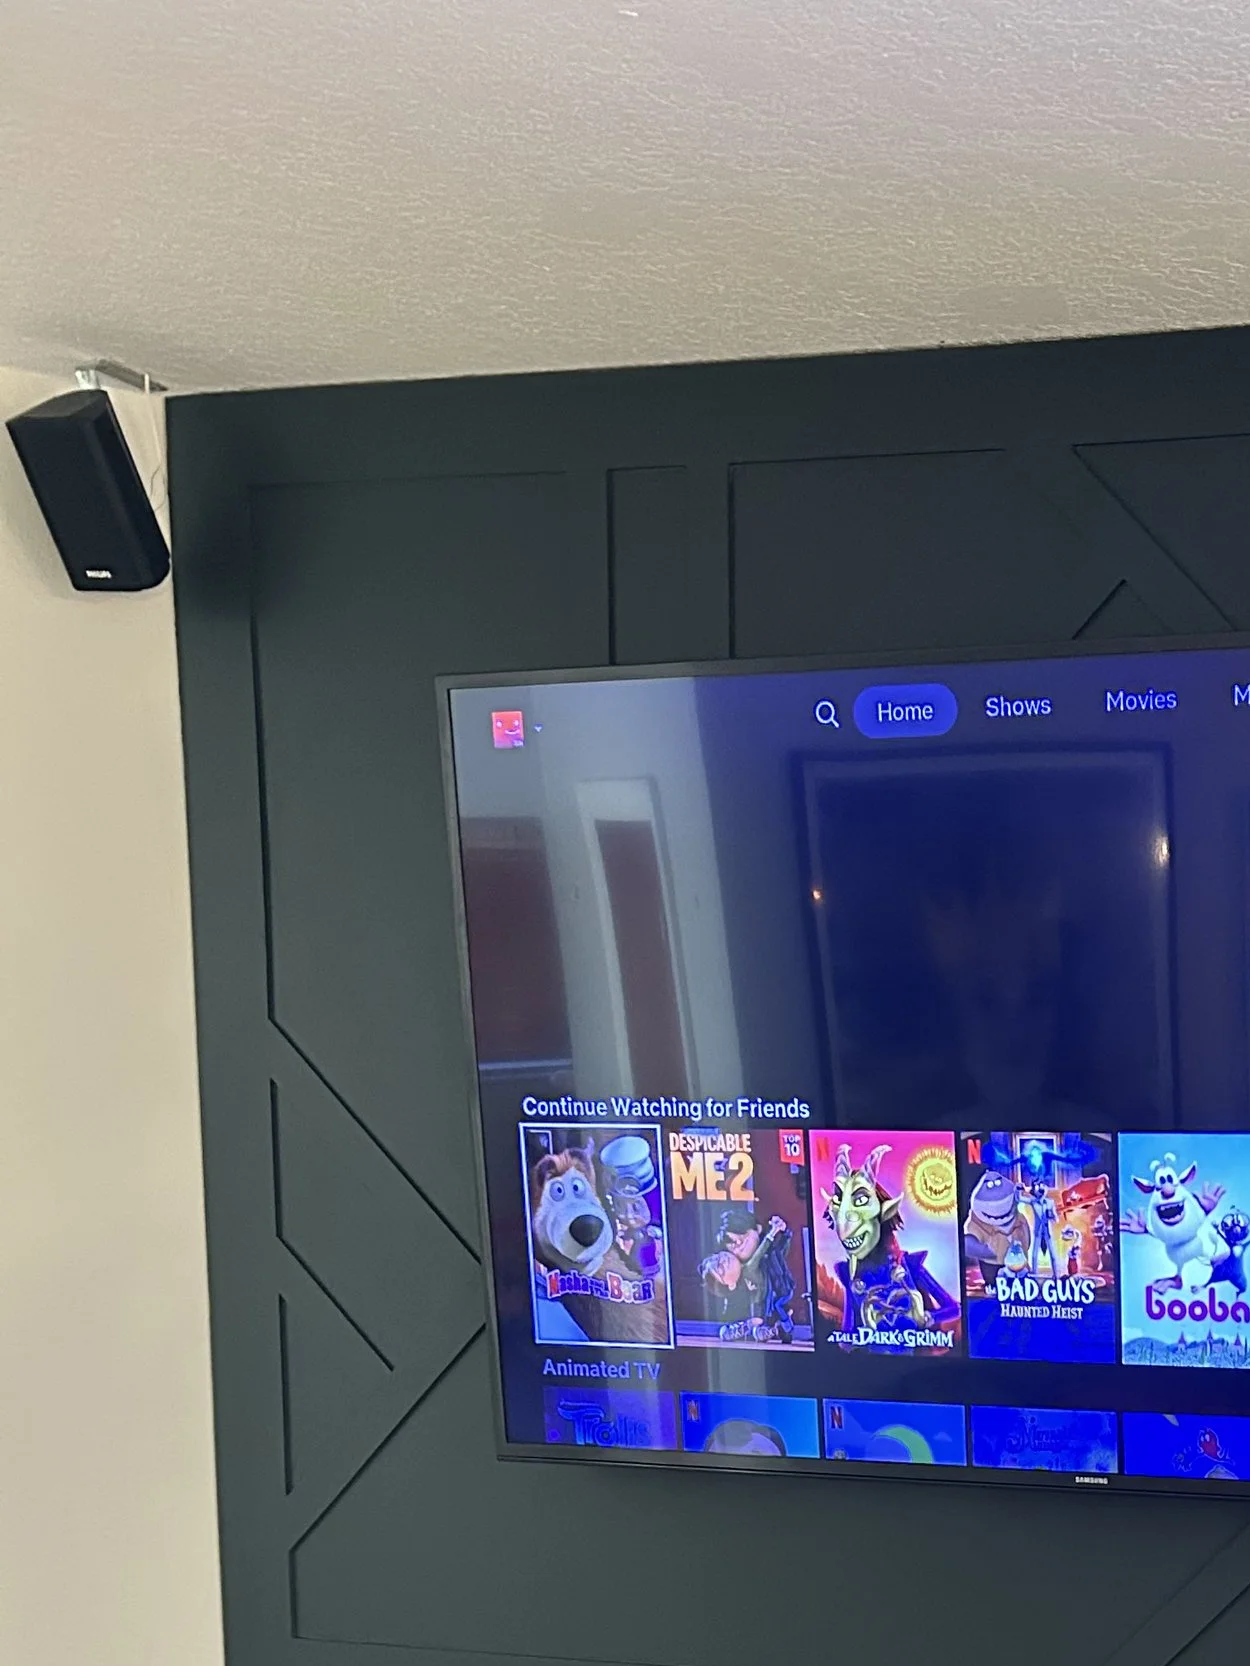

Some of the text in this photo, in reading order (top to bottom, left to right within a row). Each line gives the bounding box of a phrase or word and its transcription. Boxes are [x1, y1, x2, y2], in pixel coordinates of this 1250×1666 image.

[877, 701, 934, 722] Home
[985, 694, 1052, 718] Shows
[1106, 688, 1178, 712] Movies
[522, 1097, 811, 1122] Continue Watching for Friends
[669, 1132, 752, 1153] DESPICABLE
[782, 1135, 802, 1144] TOP
[784, 1144, 800, 1157] 10
[967, 1139, 982, 1165] N
[996, 1277, 1040, 1302] BAD
[1042, 1276, 1096, 1304] GUYS
[1000, 1303, 1084, 1319] HAUNTED HEIST
[1145, 1285, 1250, 1324] booba
[834, 1331, 858, 1343] TALE
[857, 1327, 900, 1346] DARK
[904, 1329, 955, 1348] GRIMM
[543, 1358, 661, 1381] Animated TV
